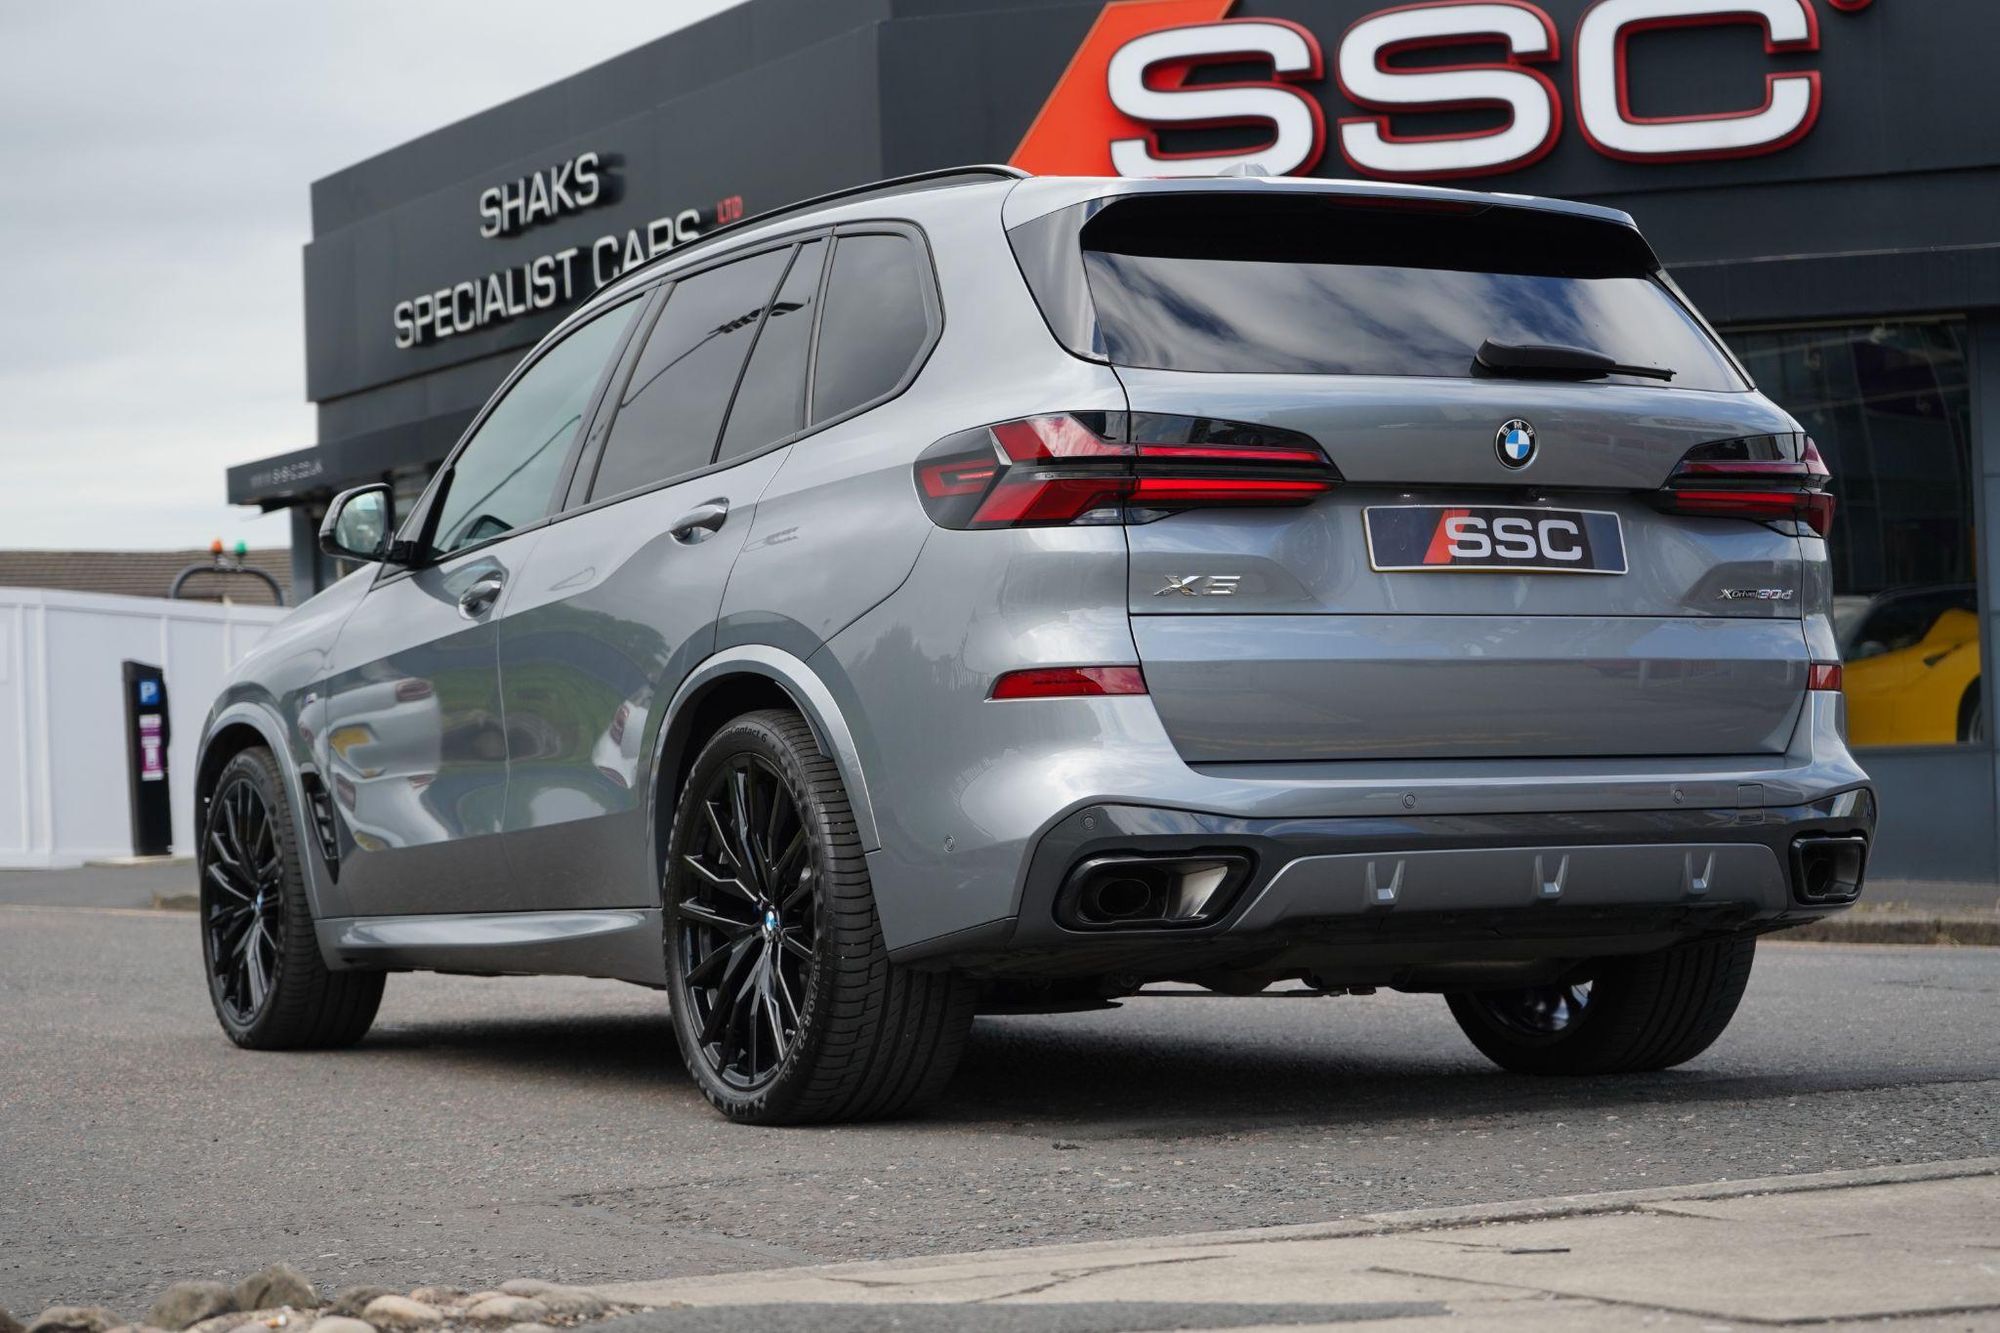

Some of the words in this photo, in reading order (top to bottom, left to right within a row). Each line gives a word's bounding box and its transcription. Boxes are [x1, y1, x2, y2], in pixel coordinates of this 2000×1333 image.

[1107, 0, 1821, 178] SSC
[479, 151, 600, 238] SHAKS
[395, 247, 579, 350] SPECIALIST
[717, 196, 743, 223] LTD
[1501, 421, 1535, 437] BMW
[1445, 516, 1583, 561] SSC
[1153, 574, 1242, 597] X5
[140, 681, 157, 703] P
